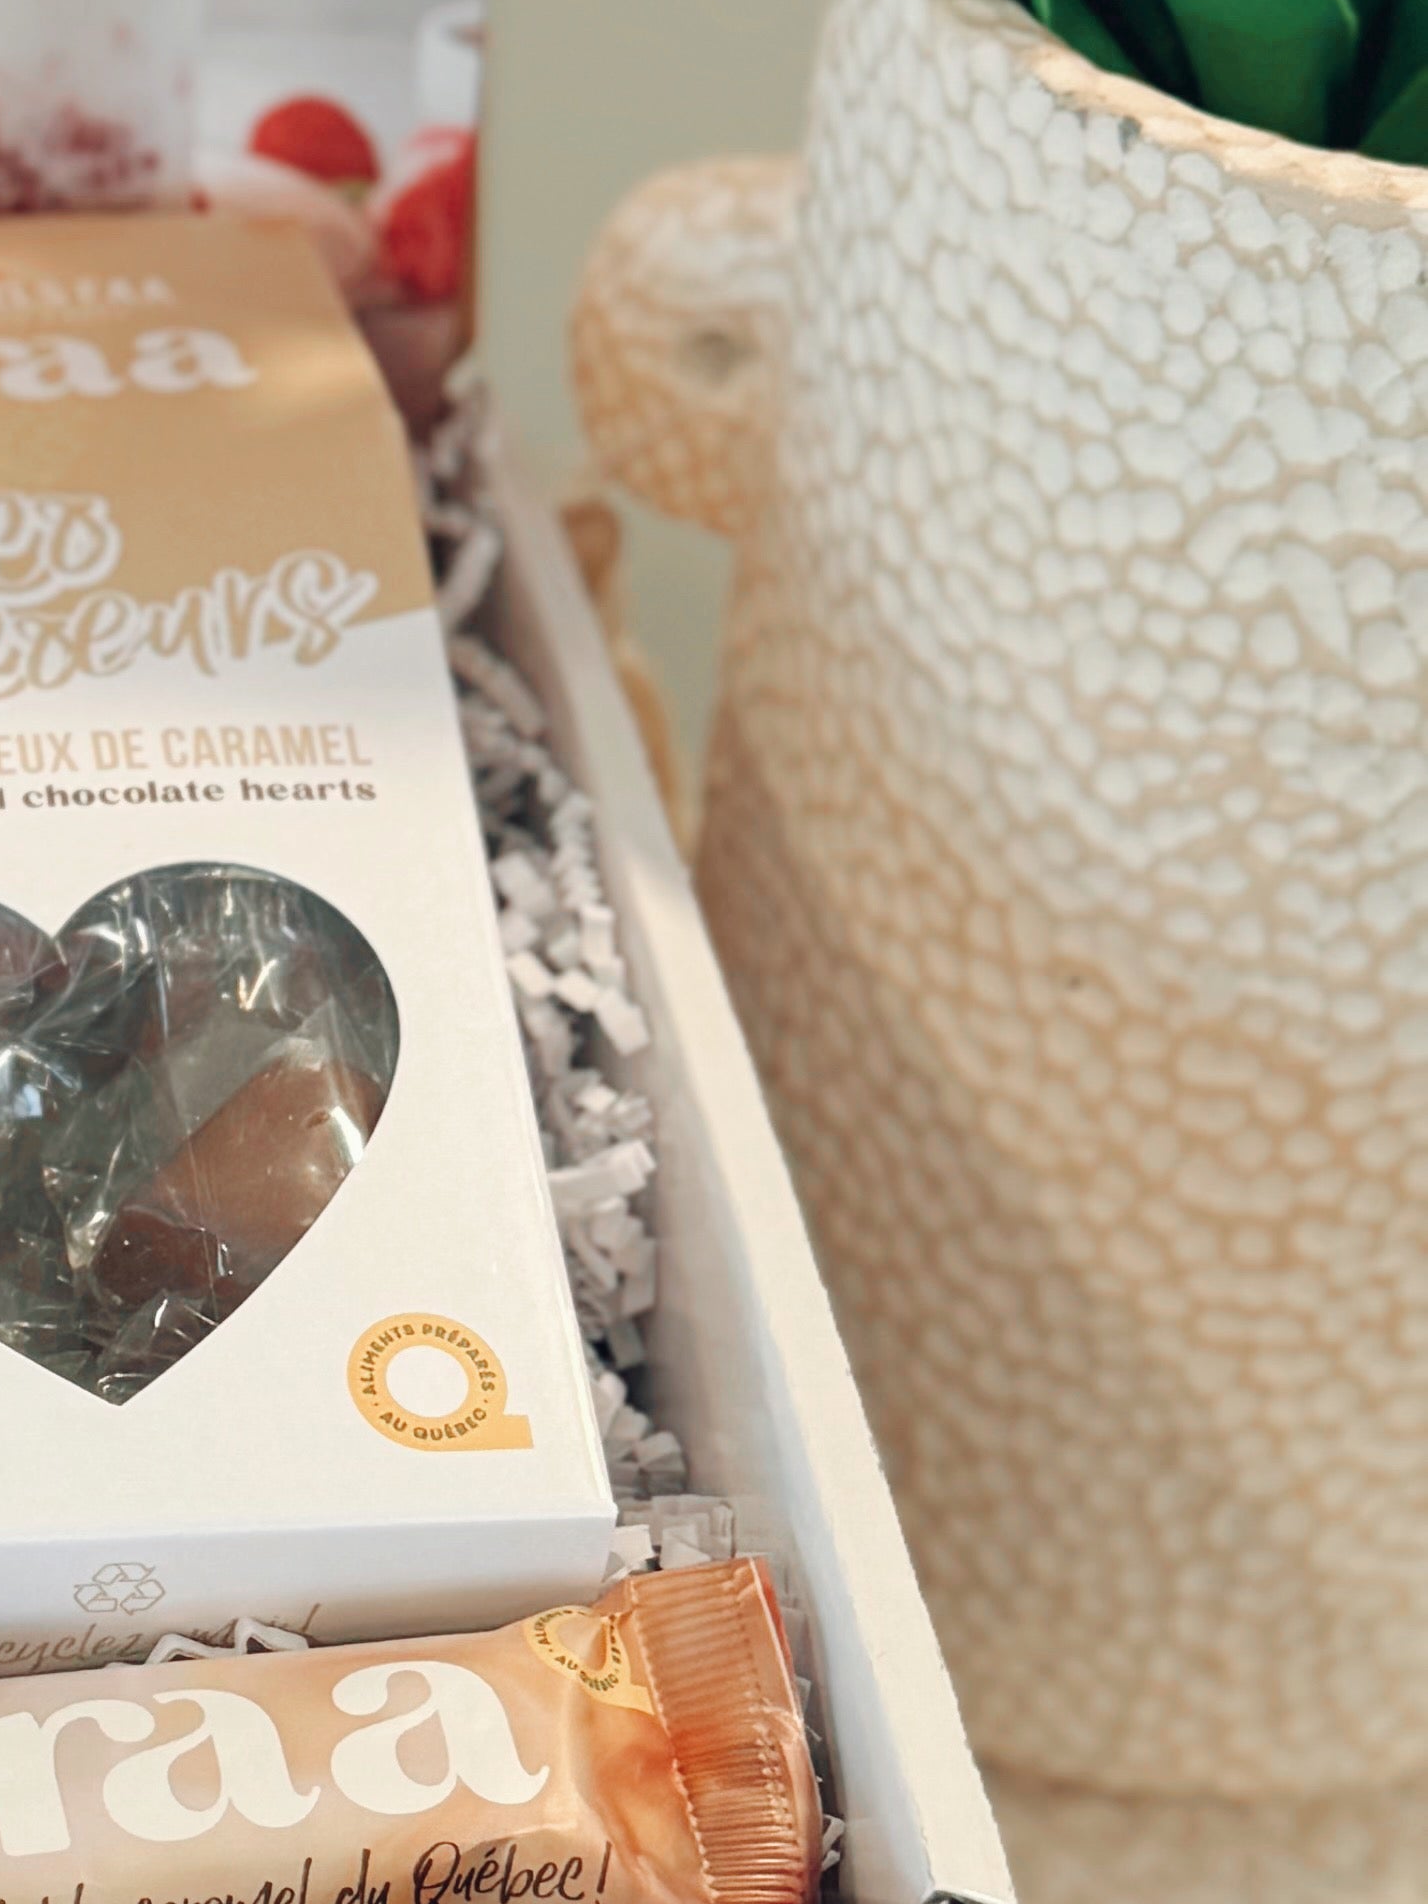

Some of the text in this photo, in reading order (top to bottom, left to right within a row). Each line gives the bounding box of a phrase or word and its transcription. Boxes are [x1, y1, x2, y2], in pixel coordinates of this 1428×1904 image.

[91, 728, 147, 772] DE
[160, 723, 374, 770] CARAMEL
[21, 779, 227, 811] chocolate
[240, 776, 379, 804] hearts
[360, 1323, 416, 1395] ALIMENTS
[421, 1322, 497, 1392] PRÉPARÉS
[379, 1410, 408, 1432] AU
